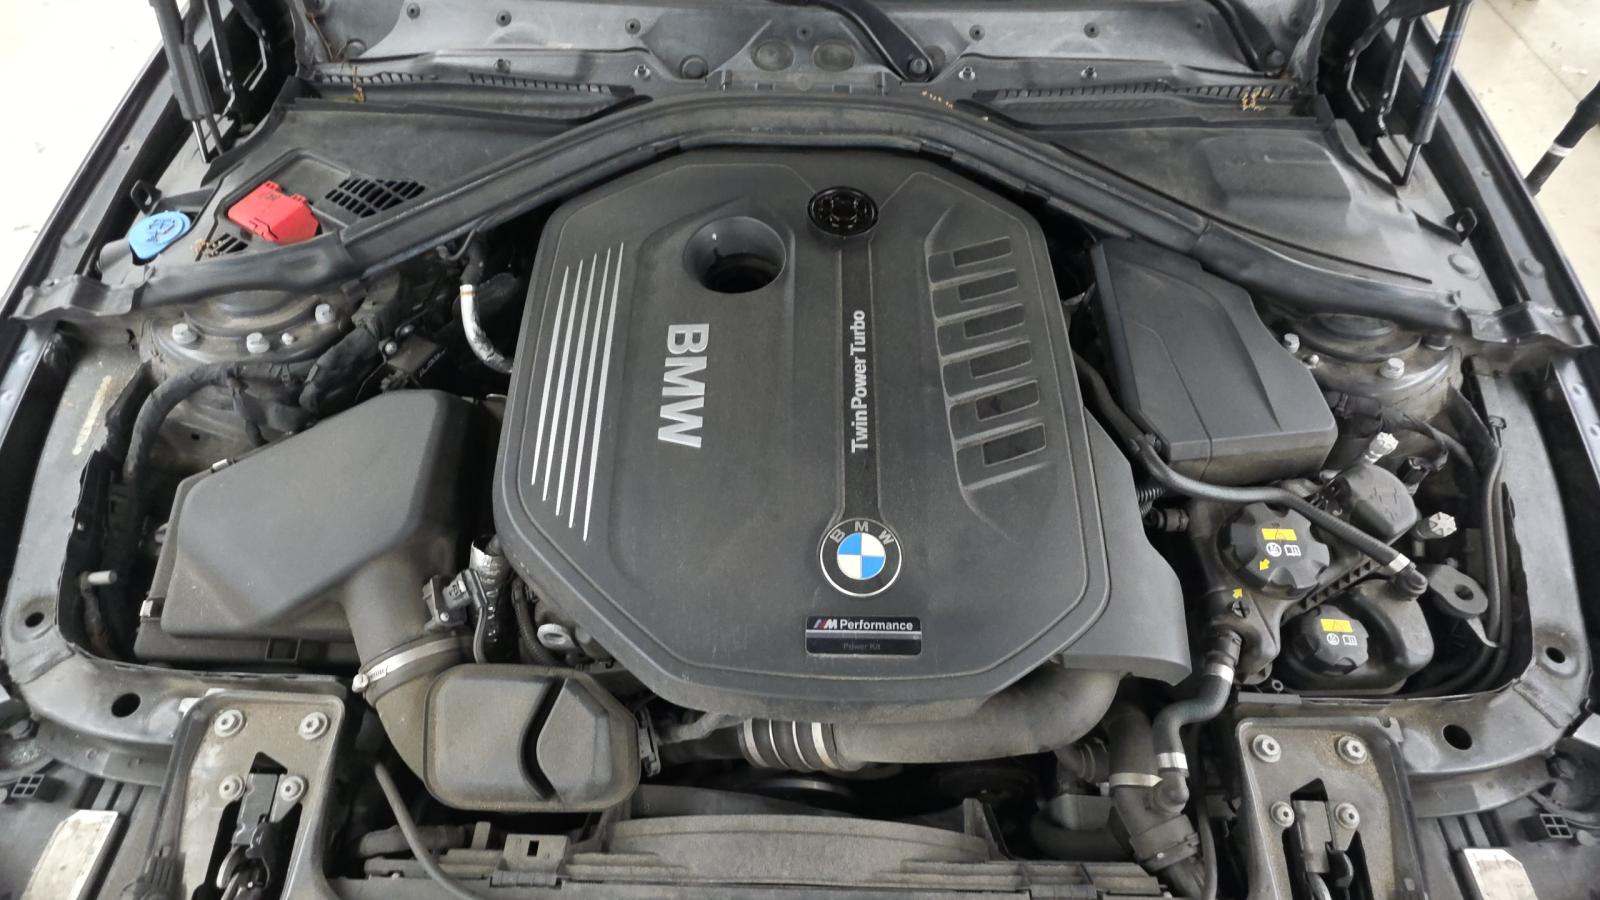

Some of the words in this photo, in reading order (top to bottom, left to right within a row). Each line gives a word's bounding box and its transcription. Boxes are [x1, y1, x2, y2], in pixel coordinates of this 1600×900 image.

[850, 310, 866, 356] Turbo
[658, 323, 710, 448] BMW
[850, 357, 868, 453] TwinPower
[829, 521, 895, 544] BMW
[840, 619, 913, 631] Performance
